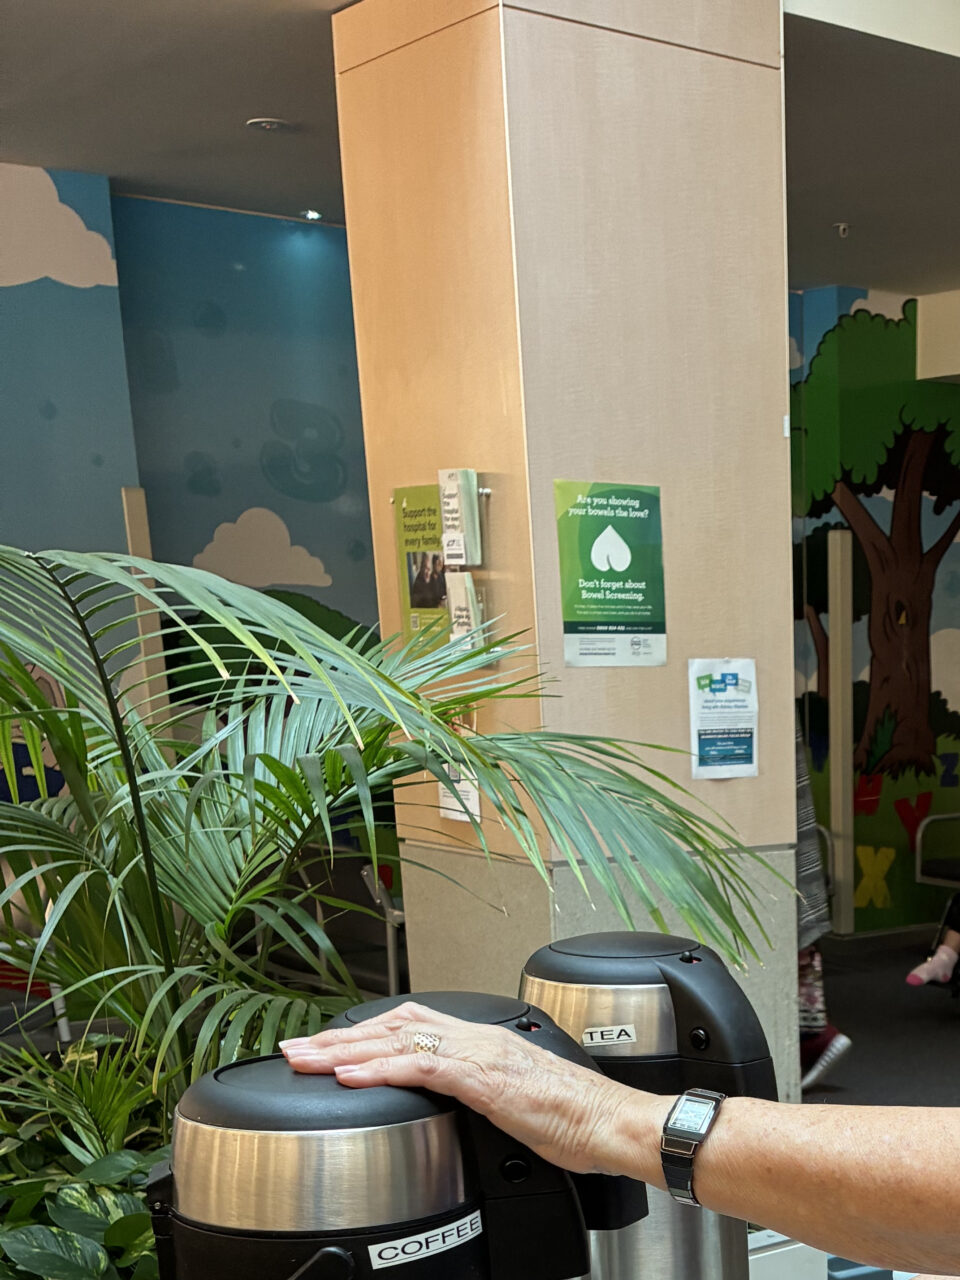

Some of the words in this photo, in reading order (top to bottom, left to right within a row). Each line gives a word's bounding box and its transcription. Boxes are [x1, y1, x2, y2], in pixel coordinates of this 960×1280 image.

[577, 494, 591, 504] Are
[592, 497, 607, 506] you
[608, 495, 640, 508] showing
[568, 507, 587, 517] your
[587, 506, 615, 517] bowels
[615, 507, 628, 517] the
[629, 507, 649, 518] love?
[578, 578, 600, 588] Don't
[600, 578, 624, 590] forget
[624, 579, 647, 589] about
[581, 590, 605, 599] Bowel
[605, 590, 645, 602] Screening.
[854, 845, 896, 908] X
[584, 1028, 631, 1041] TEA
[377, 1215, 480, 1260] COFFEE
